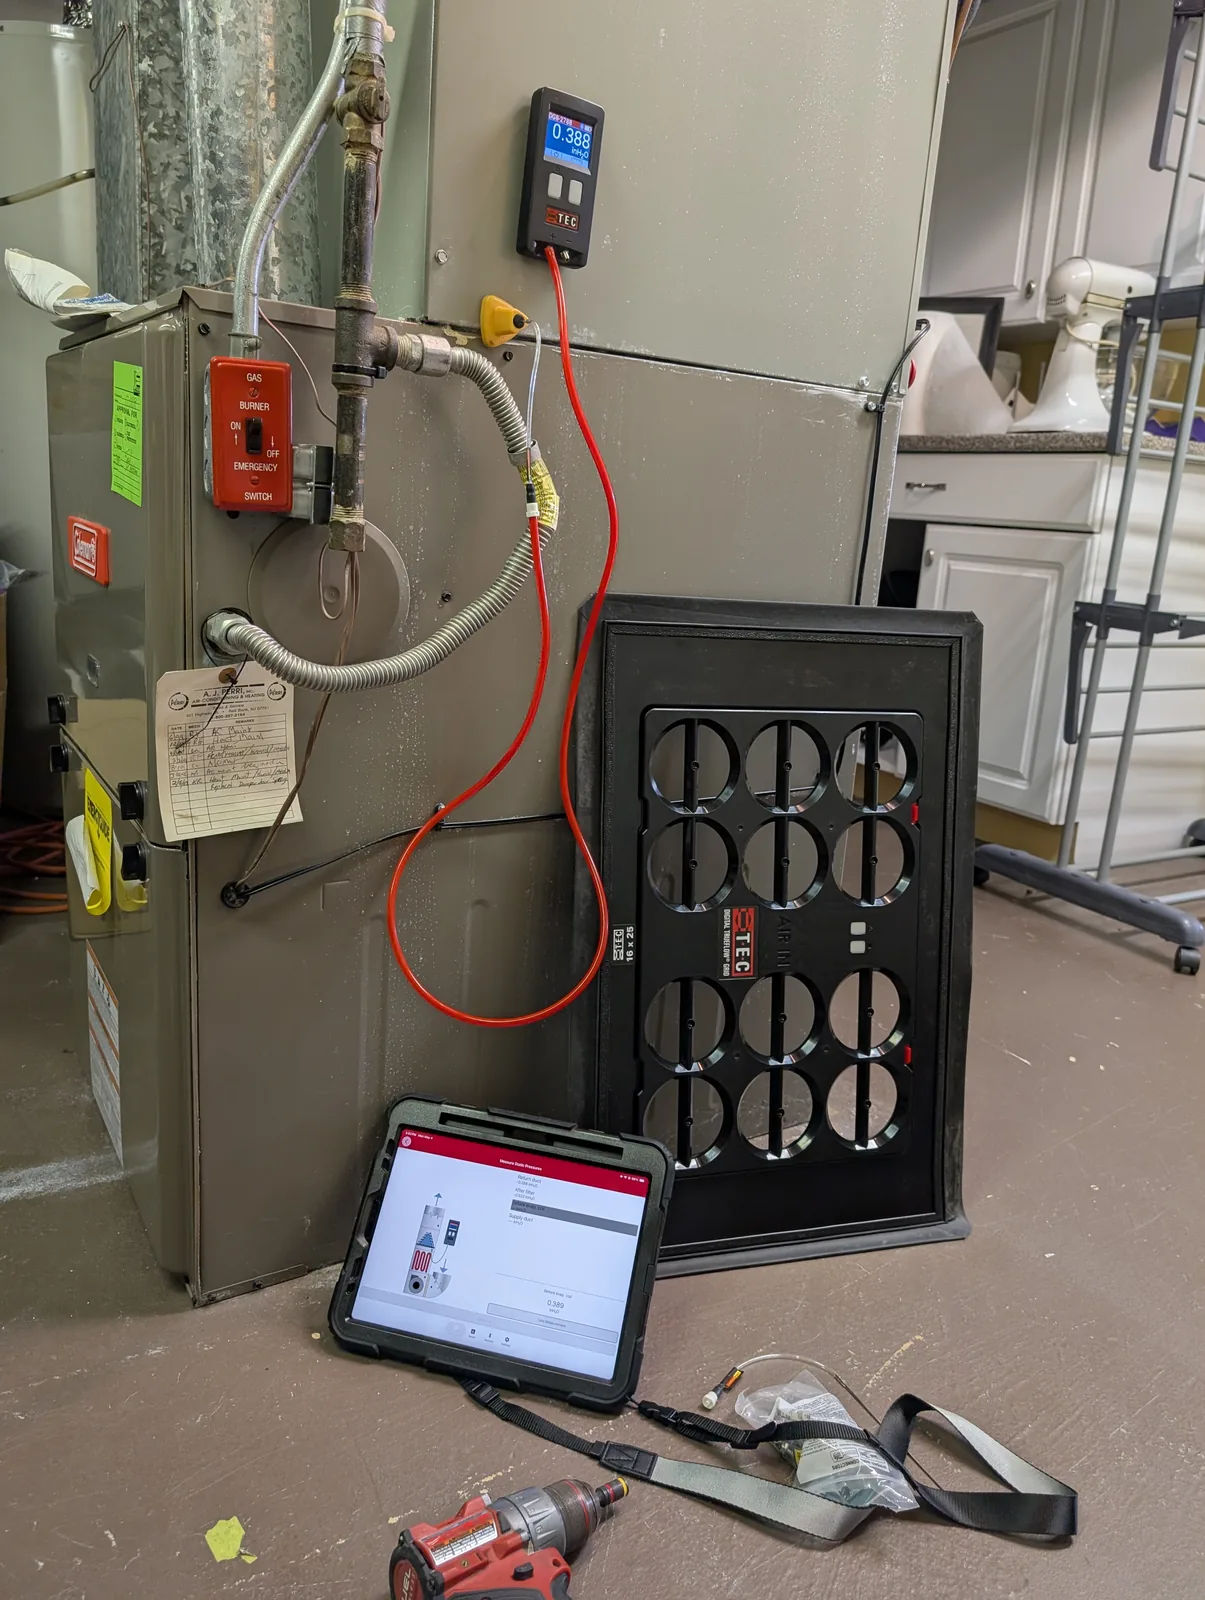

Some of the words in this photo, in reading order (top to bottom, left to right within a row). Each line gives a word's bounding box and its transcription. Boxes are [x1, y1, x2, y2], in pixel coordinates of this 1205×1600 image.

[552, 123, 590, 149] 0.388
[246, 373, 262, 383] GAS
[239, 401, 270, 411] BURNER
[230, 421, 241, 430] ON
[266, 450, 280, 458] OFF
[233, 462, 278, 472] EMERGENCY
[244, 492, 273, 501] SWITCH
[723, 909, 731, 929] DIGITAL
[626, 926, 634, 939] 25
[777, 915, 791, 944] AIR
[626, 950, 634, 962] 16
[722, 963, 730, 977] GRID
[525, 1163, 543, 1171] Pressures
[518, 1174, 532, 1182] Return
[509, 1212, 523, 1221] Supply
[547, 1299, 564, 1309] 0.389
